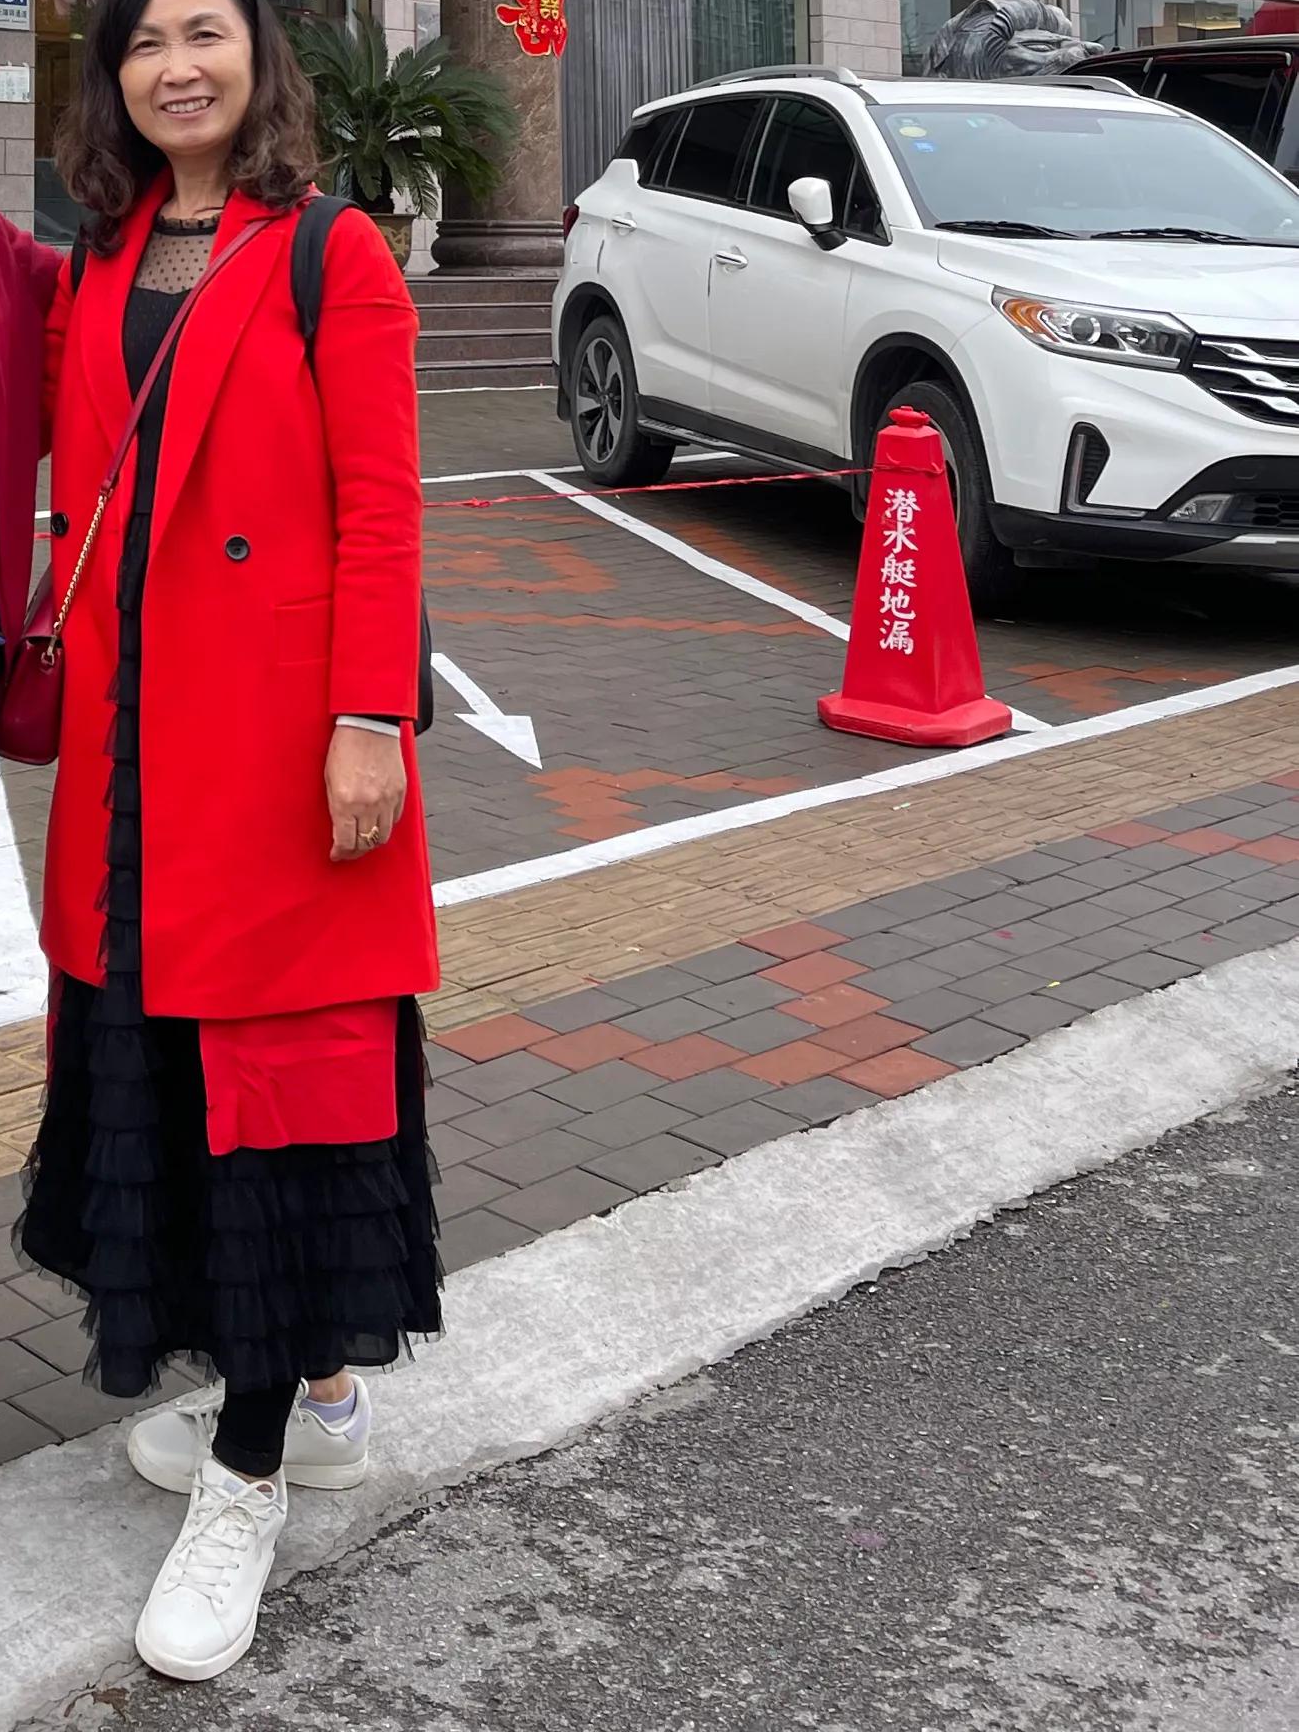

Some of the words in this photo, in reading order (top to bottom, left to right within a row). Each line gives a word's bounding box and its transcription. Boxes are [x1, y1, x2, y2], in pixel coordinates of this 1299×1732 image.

[879, 488, 921, 655] 潜水艇地漏
